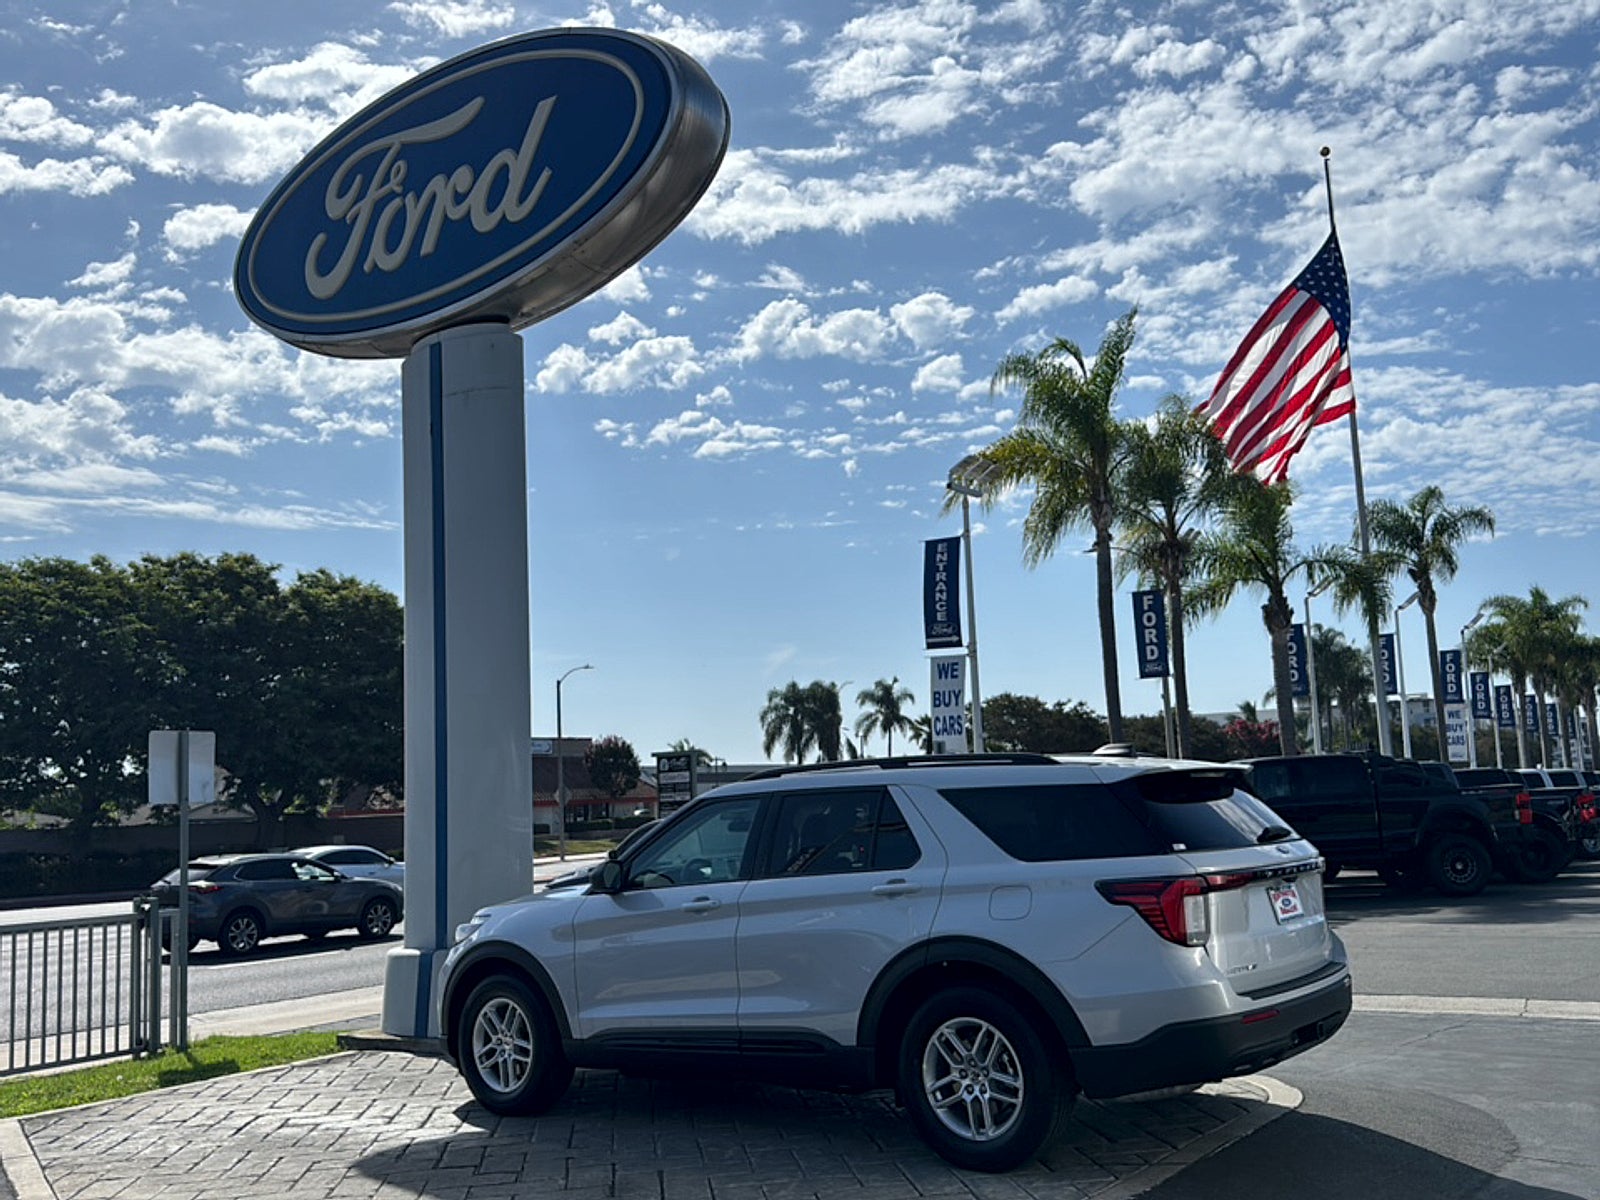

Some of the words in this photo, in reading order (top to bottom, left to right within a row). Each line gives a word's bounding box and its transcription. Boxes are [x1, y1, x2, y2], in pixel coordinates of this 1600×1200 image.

[304, 96, 557, 300] Ford
[934, 542, 948, 622] ENTRANCE
[1142, 594, 1160, 661] FORD
[937, 662, 959, 679] WE
[1286, 628, 1299, 682] FORD
[1445, 652, 1457, 693] FORD
[933, 690, 962, 708] BUY
[1475, 674, 1486, 710] FORD
[1500, 687, 1510, 718] FORD
[934, 715, 963, 737] CARS
[1447, 710, 1461, 719] WE
